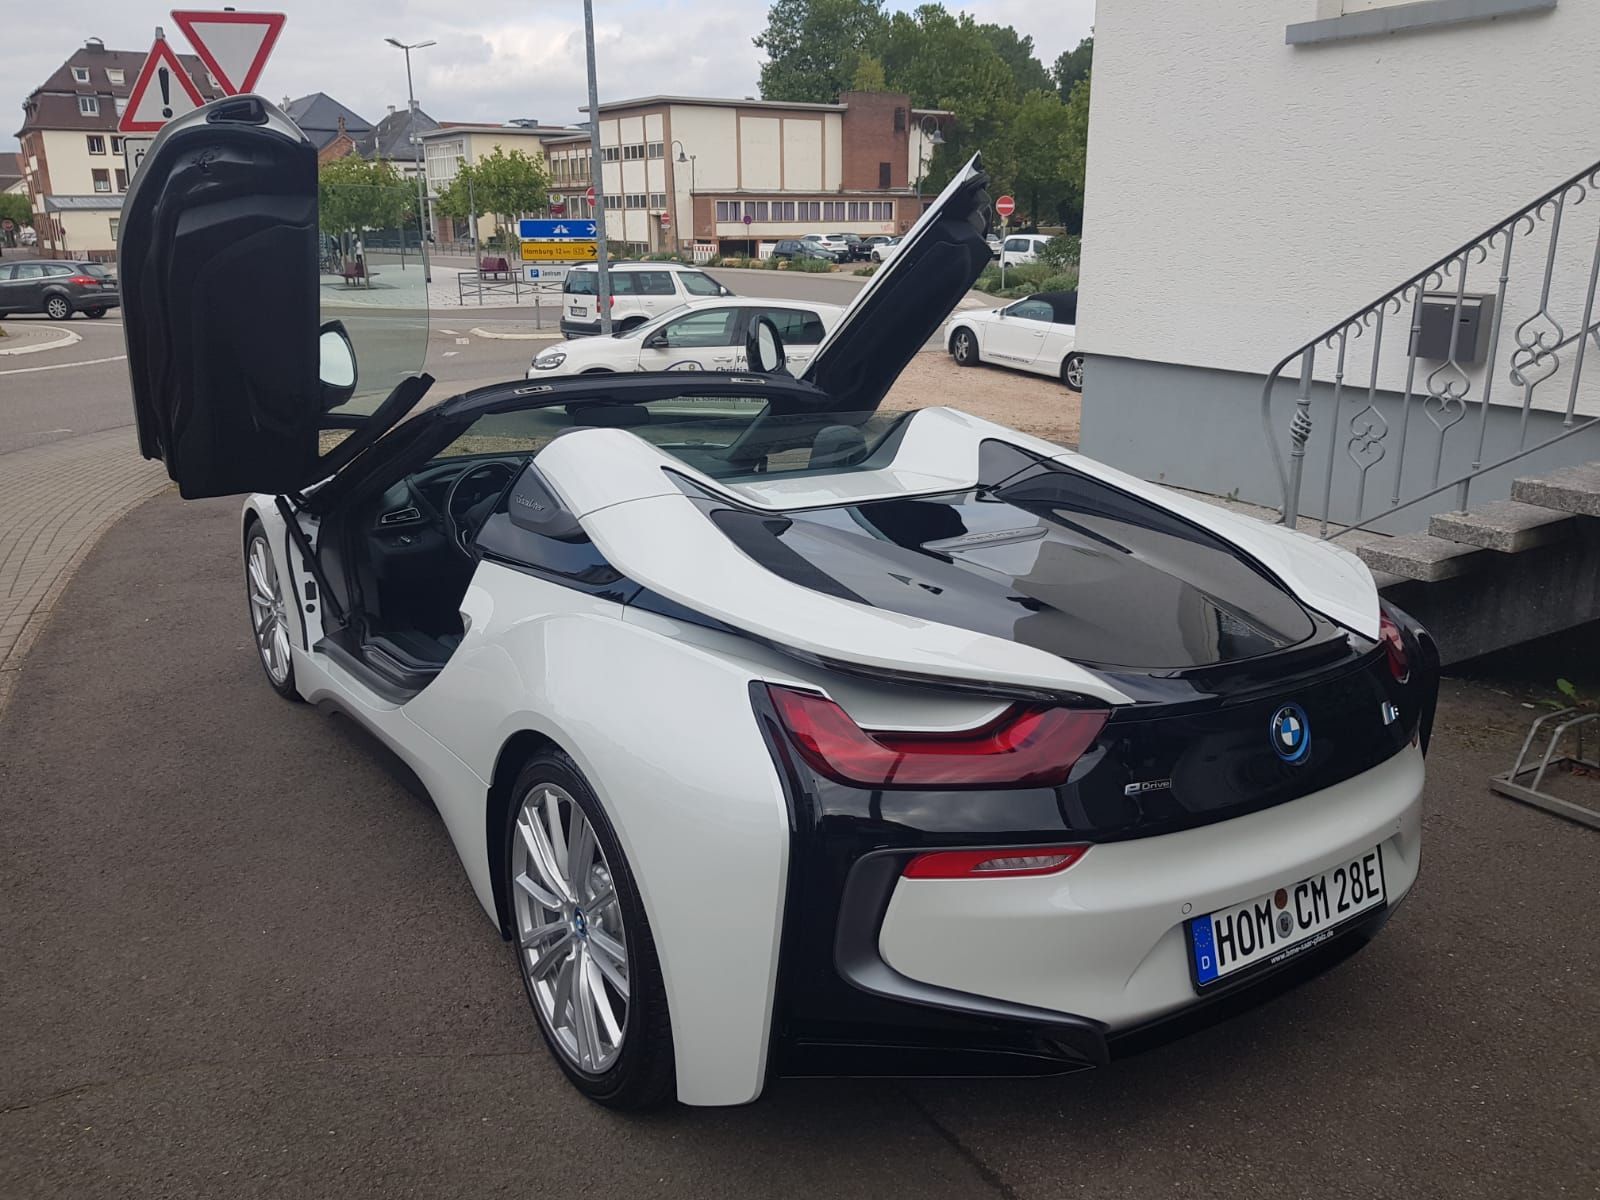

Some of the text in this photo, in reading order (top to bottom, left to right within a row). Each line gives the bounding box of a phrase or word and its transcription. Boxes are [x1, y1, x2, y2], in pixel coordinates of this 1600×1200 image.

[524, 248, 553, 256] Homburg
[1201, 853, 1379, 970] D HOM CM 28E
